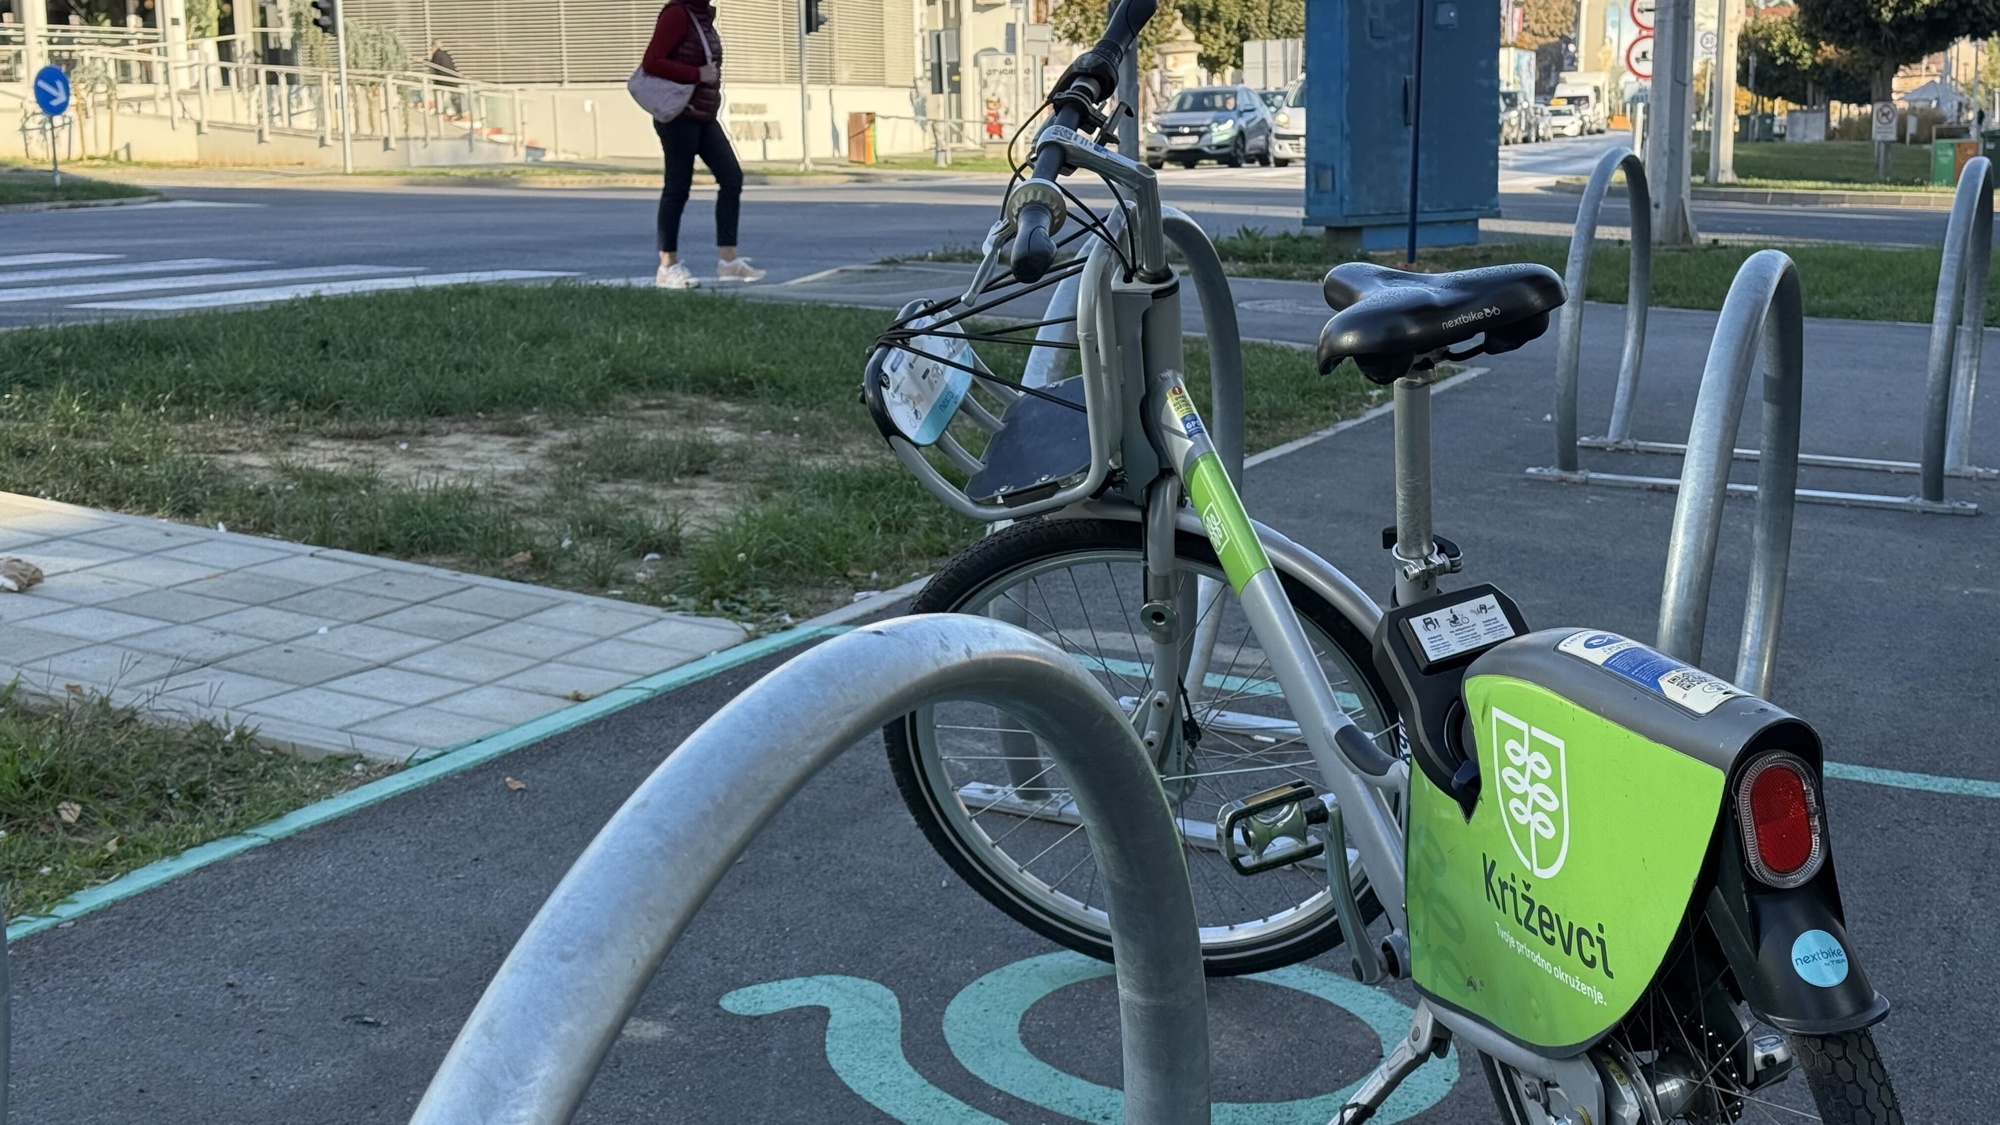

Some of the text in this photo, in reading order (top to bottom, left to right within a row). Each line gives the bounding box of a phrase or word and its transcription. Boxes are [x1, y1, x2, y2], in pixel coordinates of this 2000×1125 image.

[1441, 311, 1484, 330] nextbike
[1482, 852, 1614, 980] Križevci
[1495, 921, 1607, 1006] Tvoje prirodno okruženje.
[1795, 947, 1843, 966] nextbike
